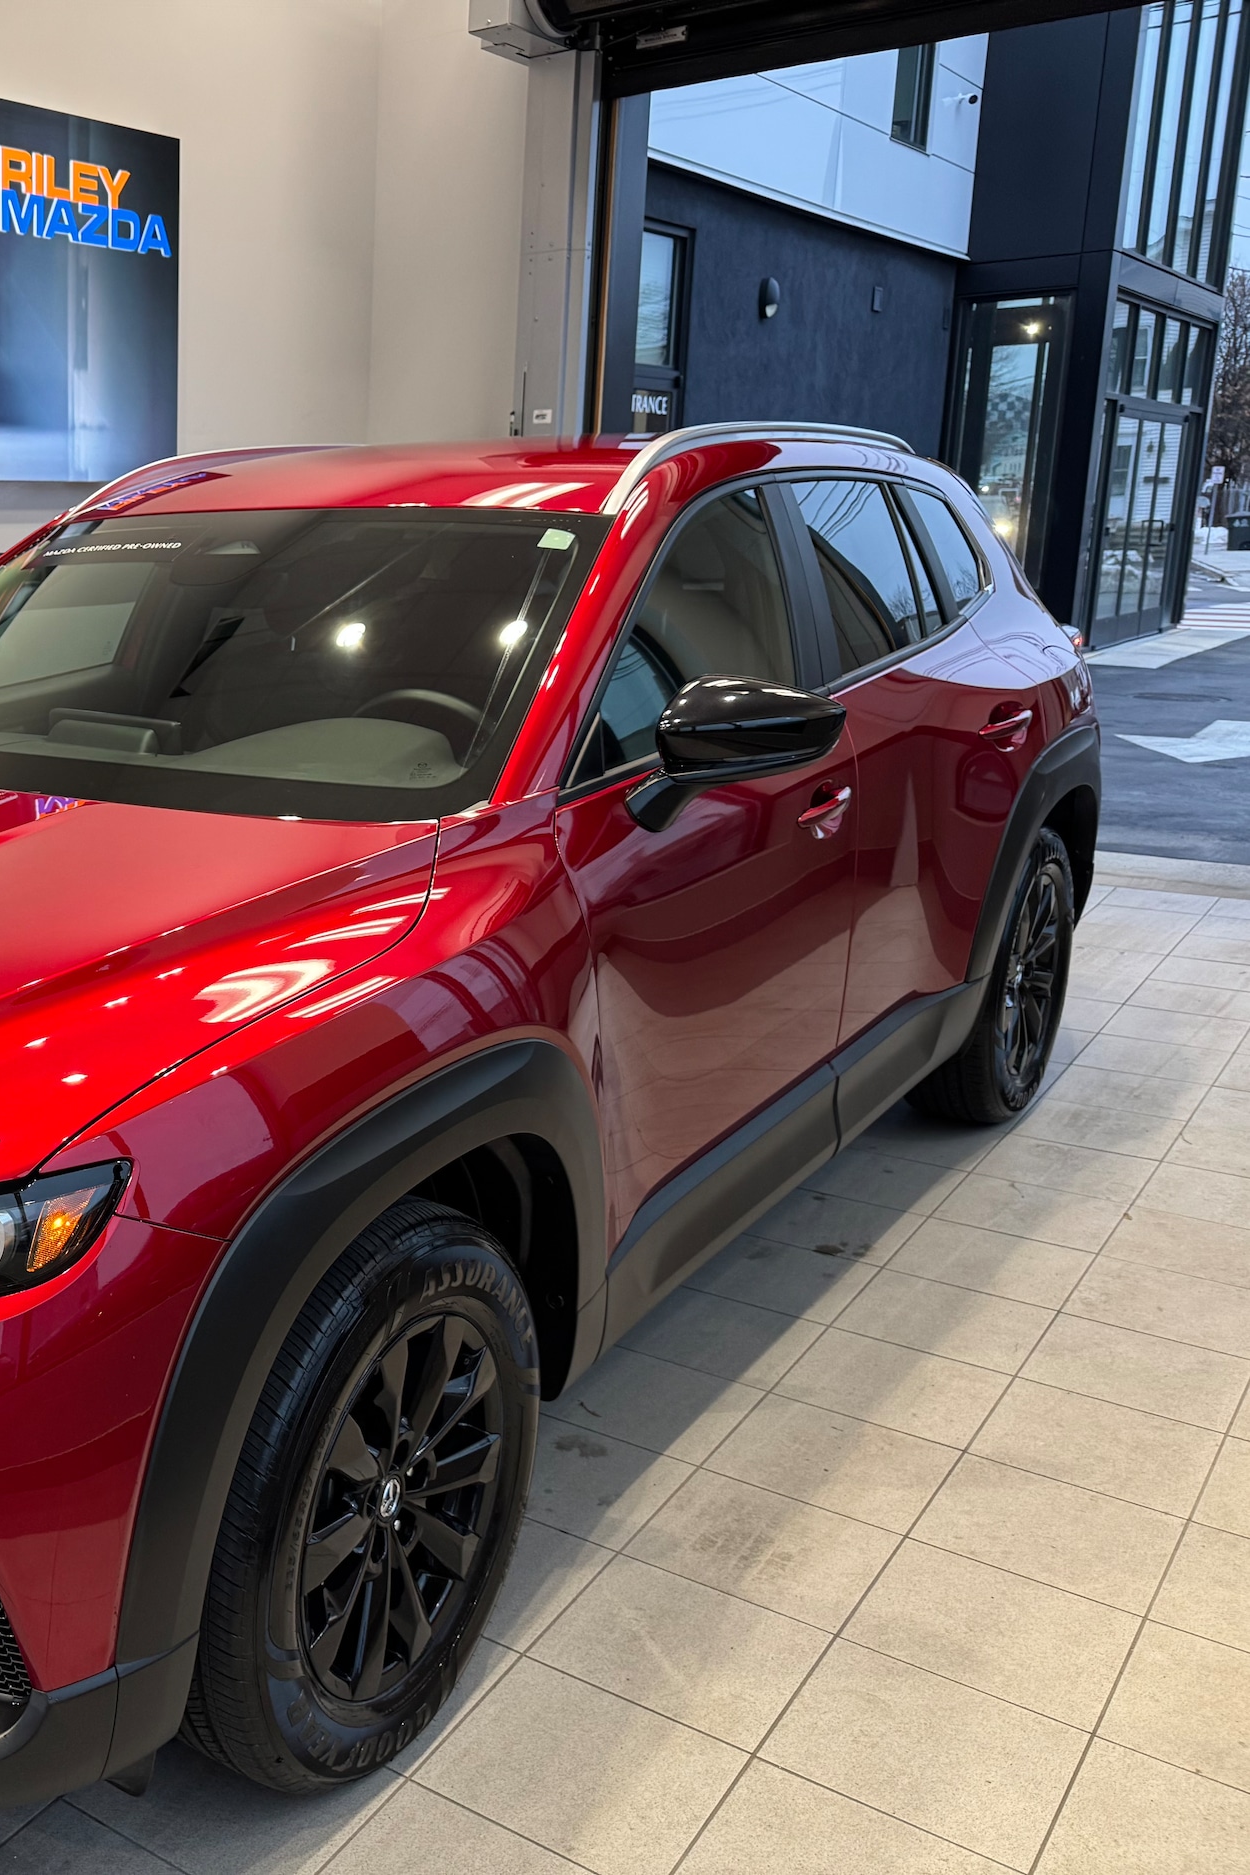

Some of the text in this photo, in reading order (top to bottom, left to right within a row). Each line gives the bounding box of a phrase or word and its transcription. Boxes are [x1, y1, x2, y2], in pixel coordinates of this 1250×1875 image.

[43, 547, 76, 557] MAZDA
[77, 544, 122, 553] CERTIFIED
[419, 1259, 533, 1351] ASSURANCE
